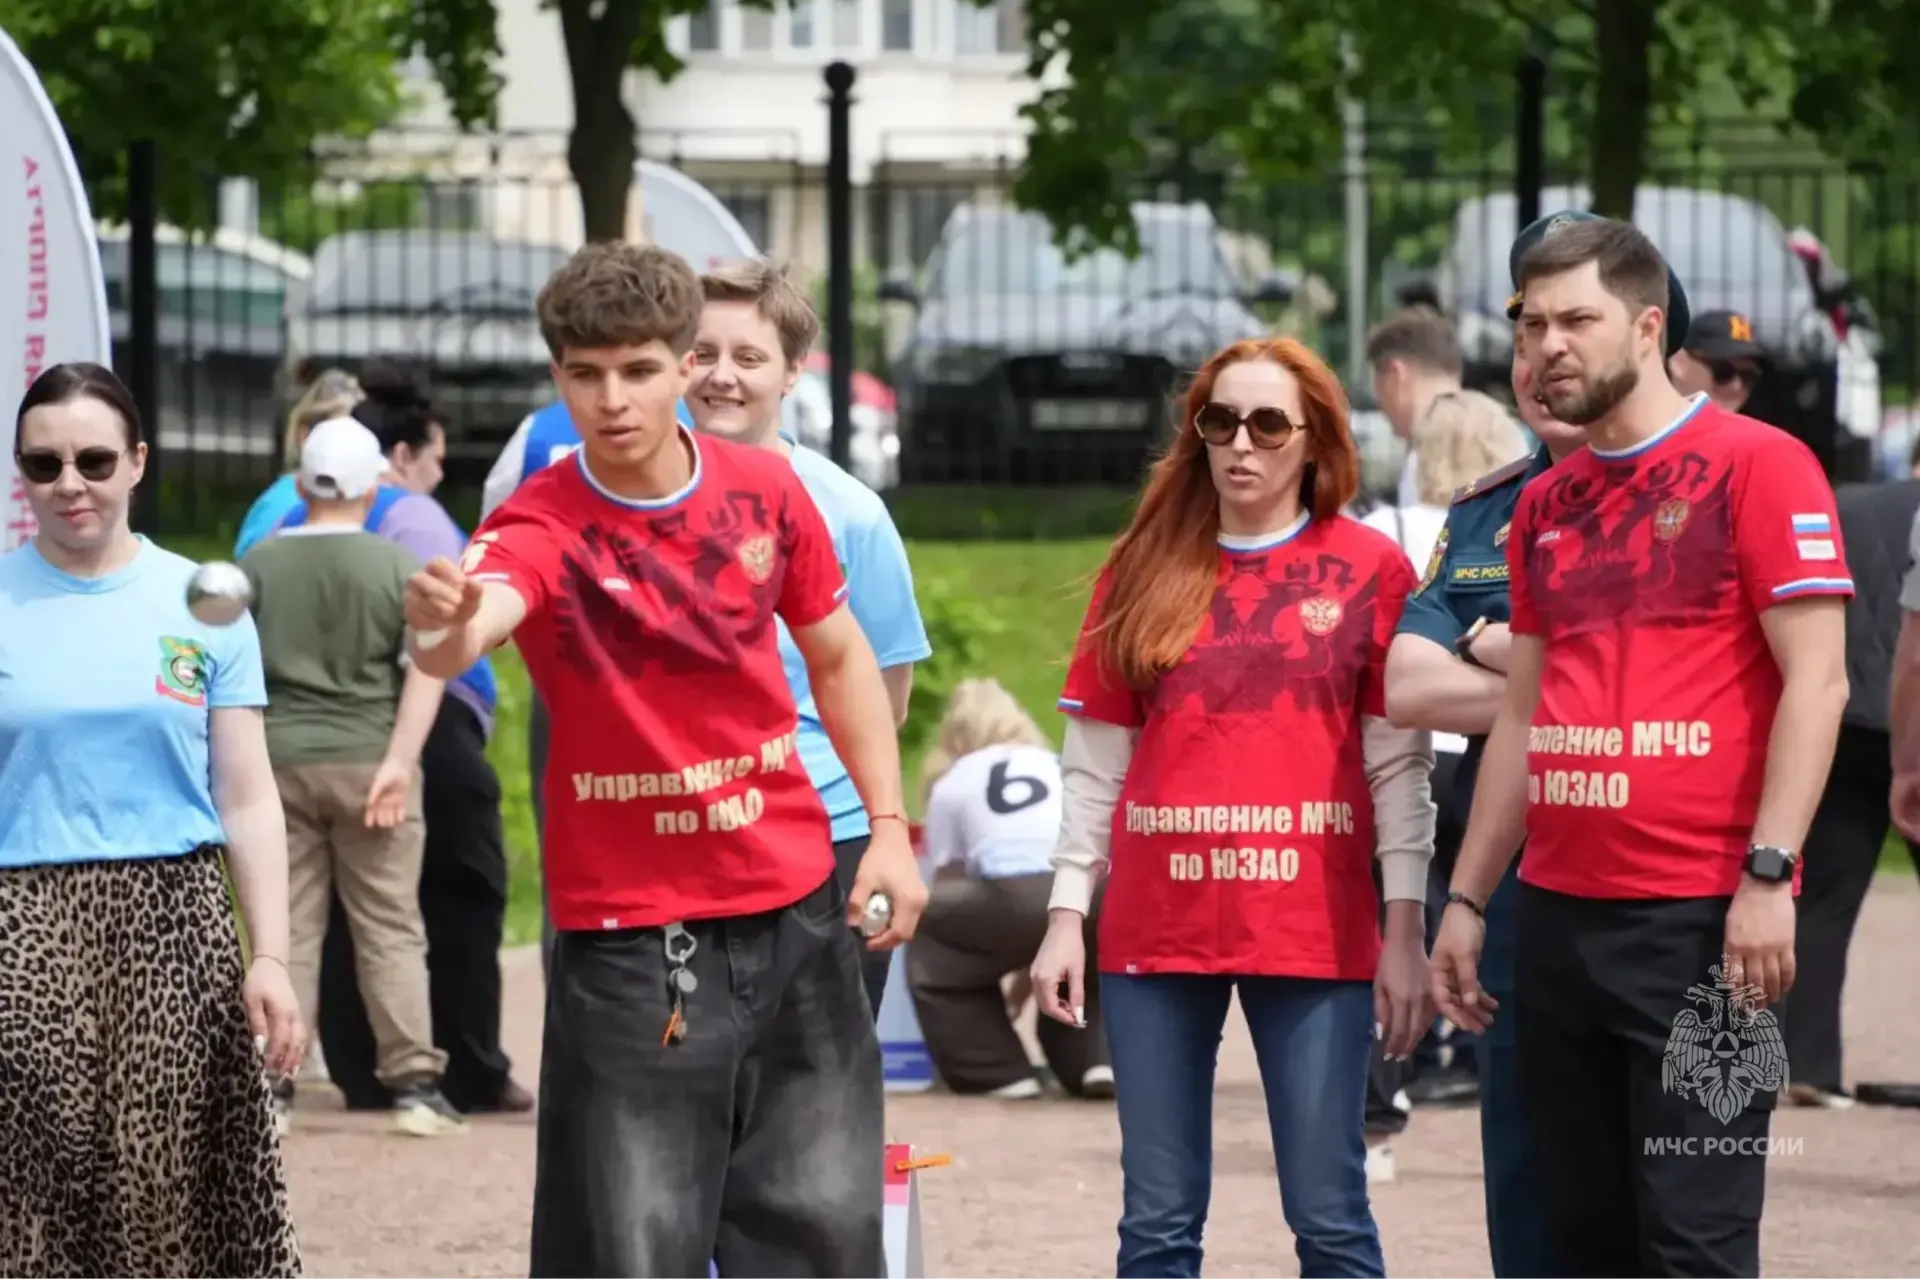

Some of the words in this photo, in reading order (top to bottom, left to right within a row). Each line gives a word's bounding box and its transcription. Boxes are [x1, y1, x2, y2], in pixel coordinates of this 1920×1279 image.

[1455, 568, 1480, 581] МЧС
[1481, 564, 1510, 579] РОСС
[1631, 720, 1711, 757] МЧС
[986, 760, 1049, 814] 6
[1544, 768, 1630, 808] ЮЗАО
[653, 810, 699, 835] по
[1126, 801, 1293, 836] Управление
[1300, 801, 1354, 835] МЧС
[1170, 853, 1204, 881] по
[1210, 848, 1300, 882] ЮЗАО
